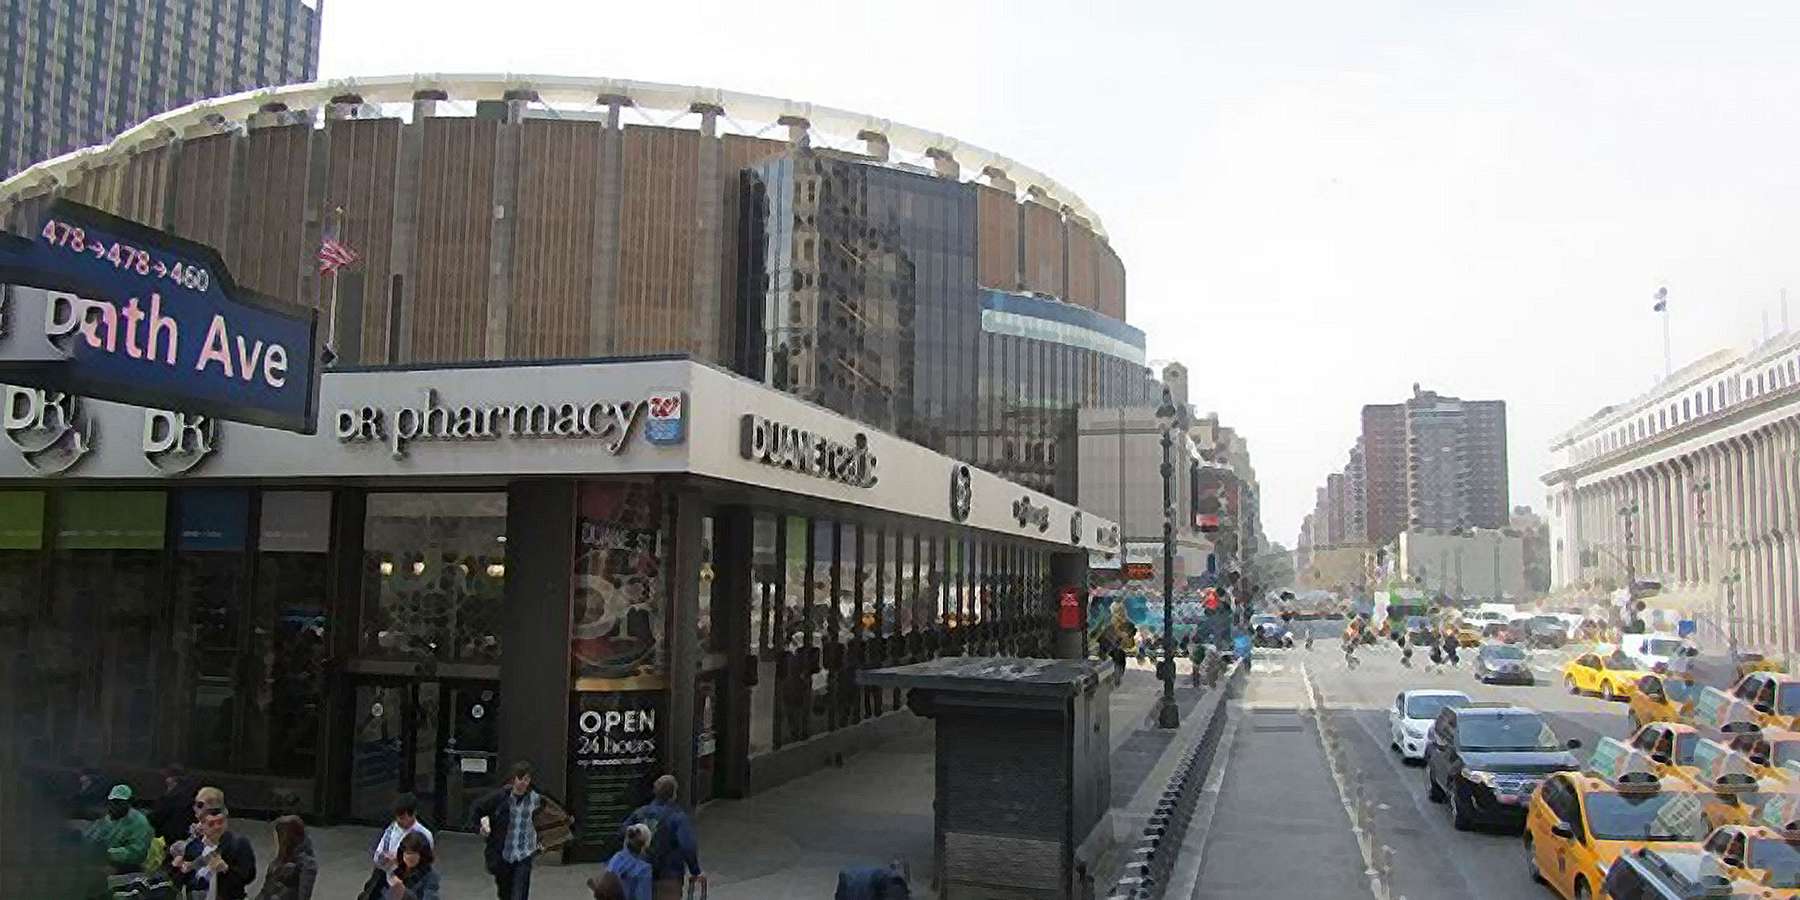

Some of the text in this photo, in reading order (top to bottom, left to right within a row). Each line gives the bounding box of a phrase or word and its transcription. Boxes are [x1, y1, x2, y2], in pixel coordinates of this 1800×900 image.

[42, 219, 86, 253] 478
[107, 242, 151, 276] 478
[195, 314, 289, 388] Ave
[392, 387, 648, 460] pharmacy
[579, 709, 656, 734] OPEN
